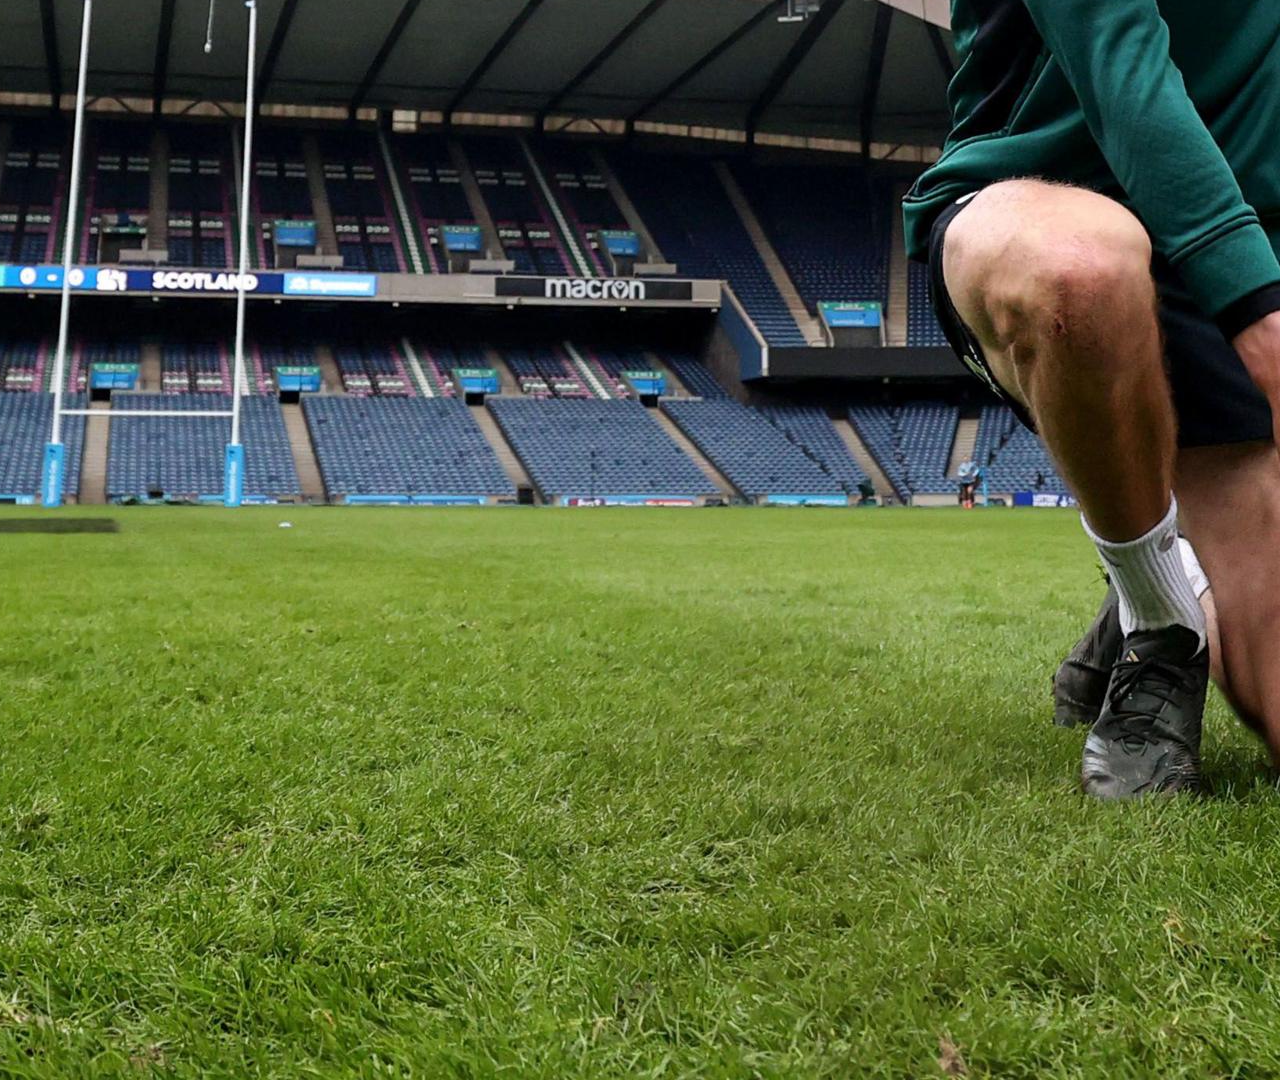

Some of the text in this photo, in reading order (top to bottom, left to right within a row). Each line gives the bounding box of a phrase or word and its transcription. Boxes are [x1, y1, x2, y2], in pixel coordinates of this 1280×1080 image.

[20, 267, 37, 285] 0
[67, 268, 85, 286] 0
[152, 270, 259, 291] SCOTLAND
[545, 279, 646, 299] macron
